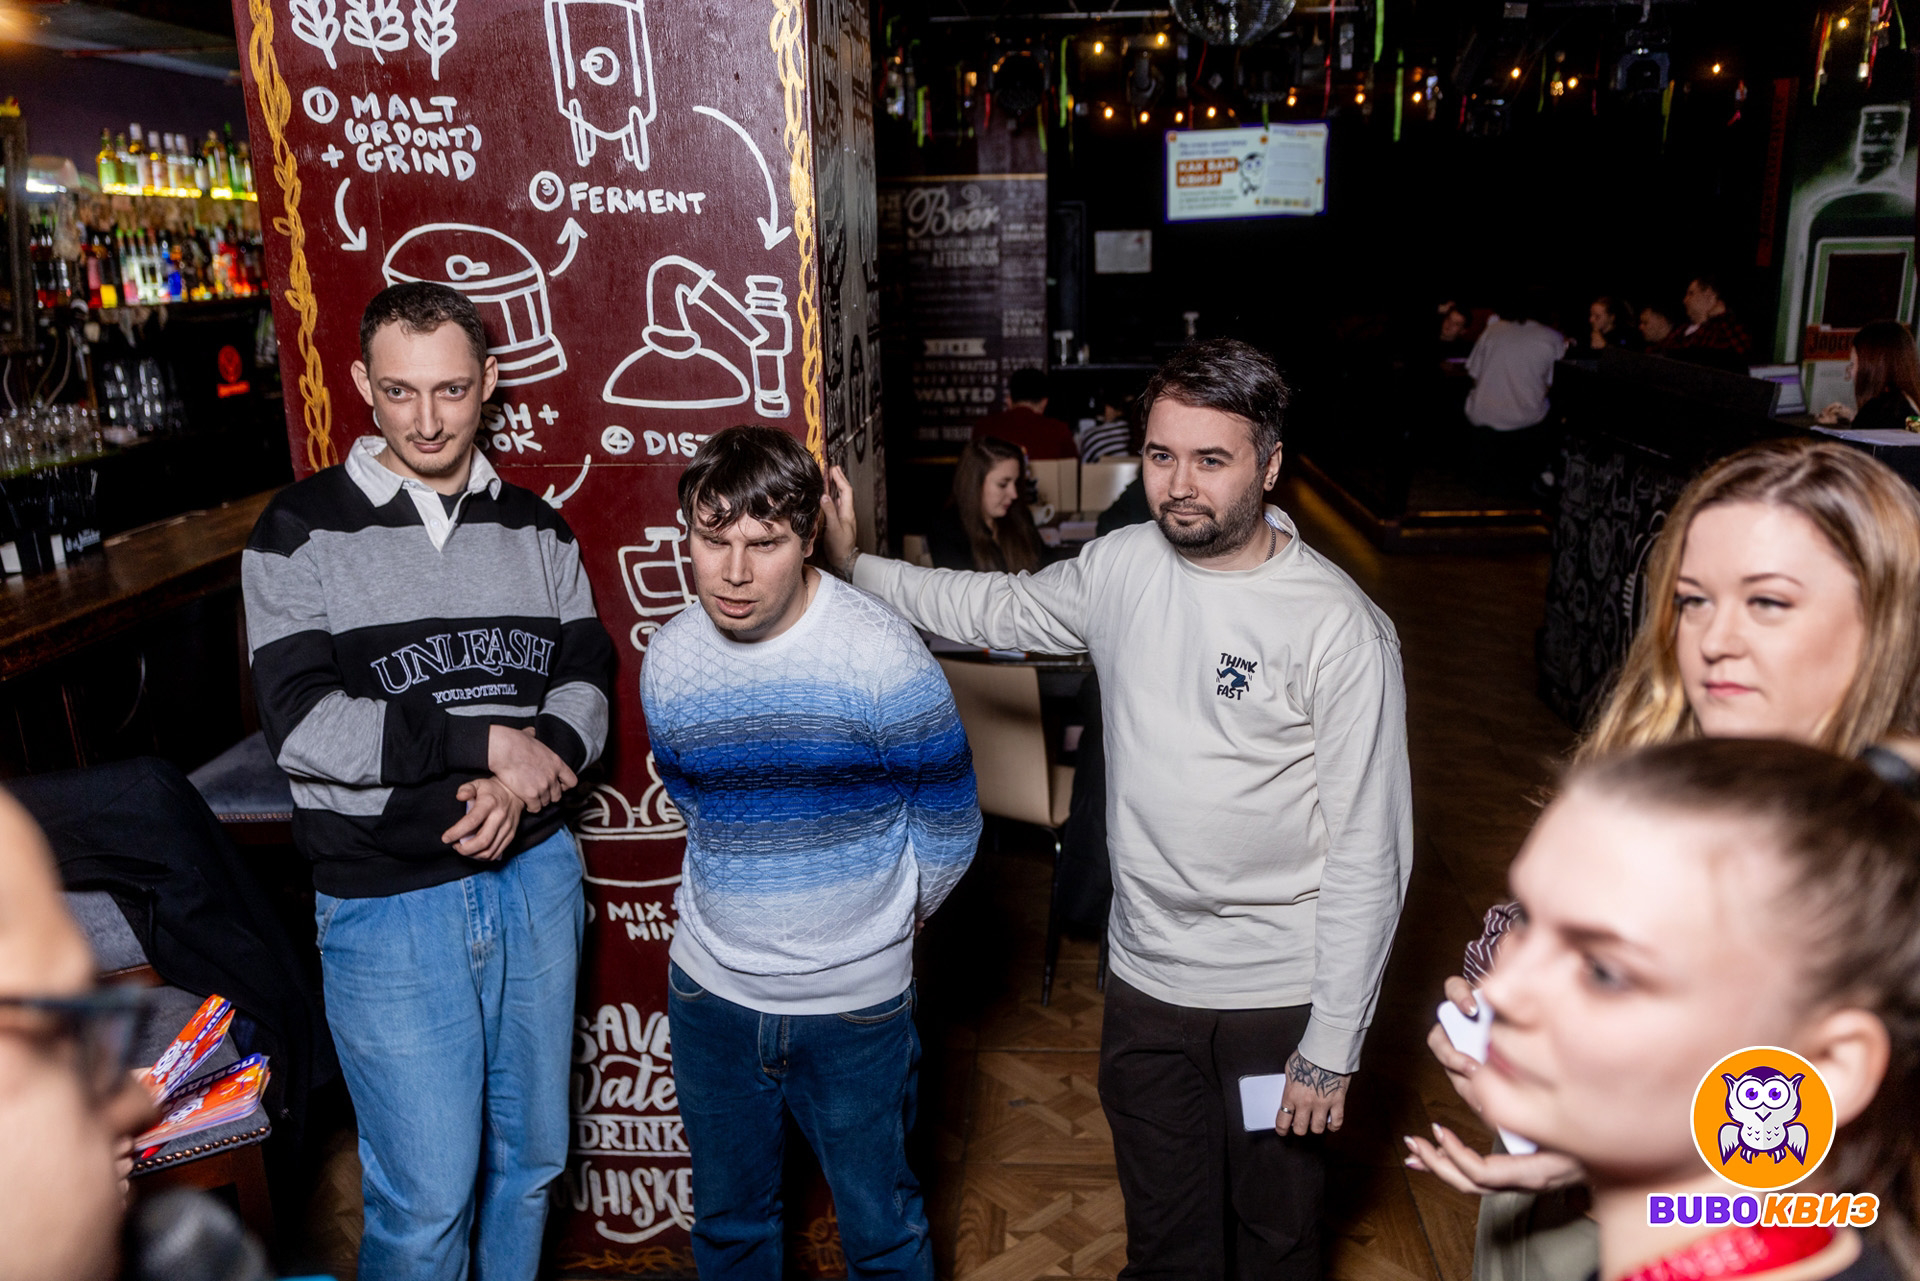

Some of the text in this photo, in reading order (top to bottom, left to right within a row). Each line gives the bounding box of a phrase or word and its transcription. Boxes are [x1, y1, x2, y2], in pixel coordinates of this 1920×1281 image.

[351, 91, 457, 124] MALT
[356, 142, 476, 181] GRIND
[569, 182, 706, 215] FERMENT
[904, 184, 1000, 238] Beer
[481, 402, 533, 431] SH
[370, 627, 555, 694] UNLEASH
[1220, 652, 1258, 673] THINK
[1216, 684, 1244, 700] FAST
[607, 901, 667, 922] MIX
[578, 1119, 690, 1151] DRINK
